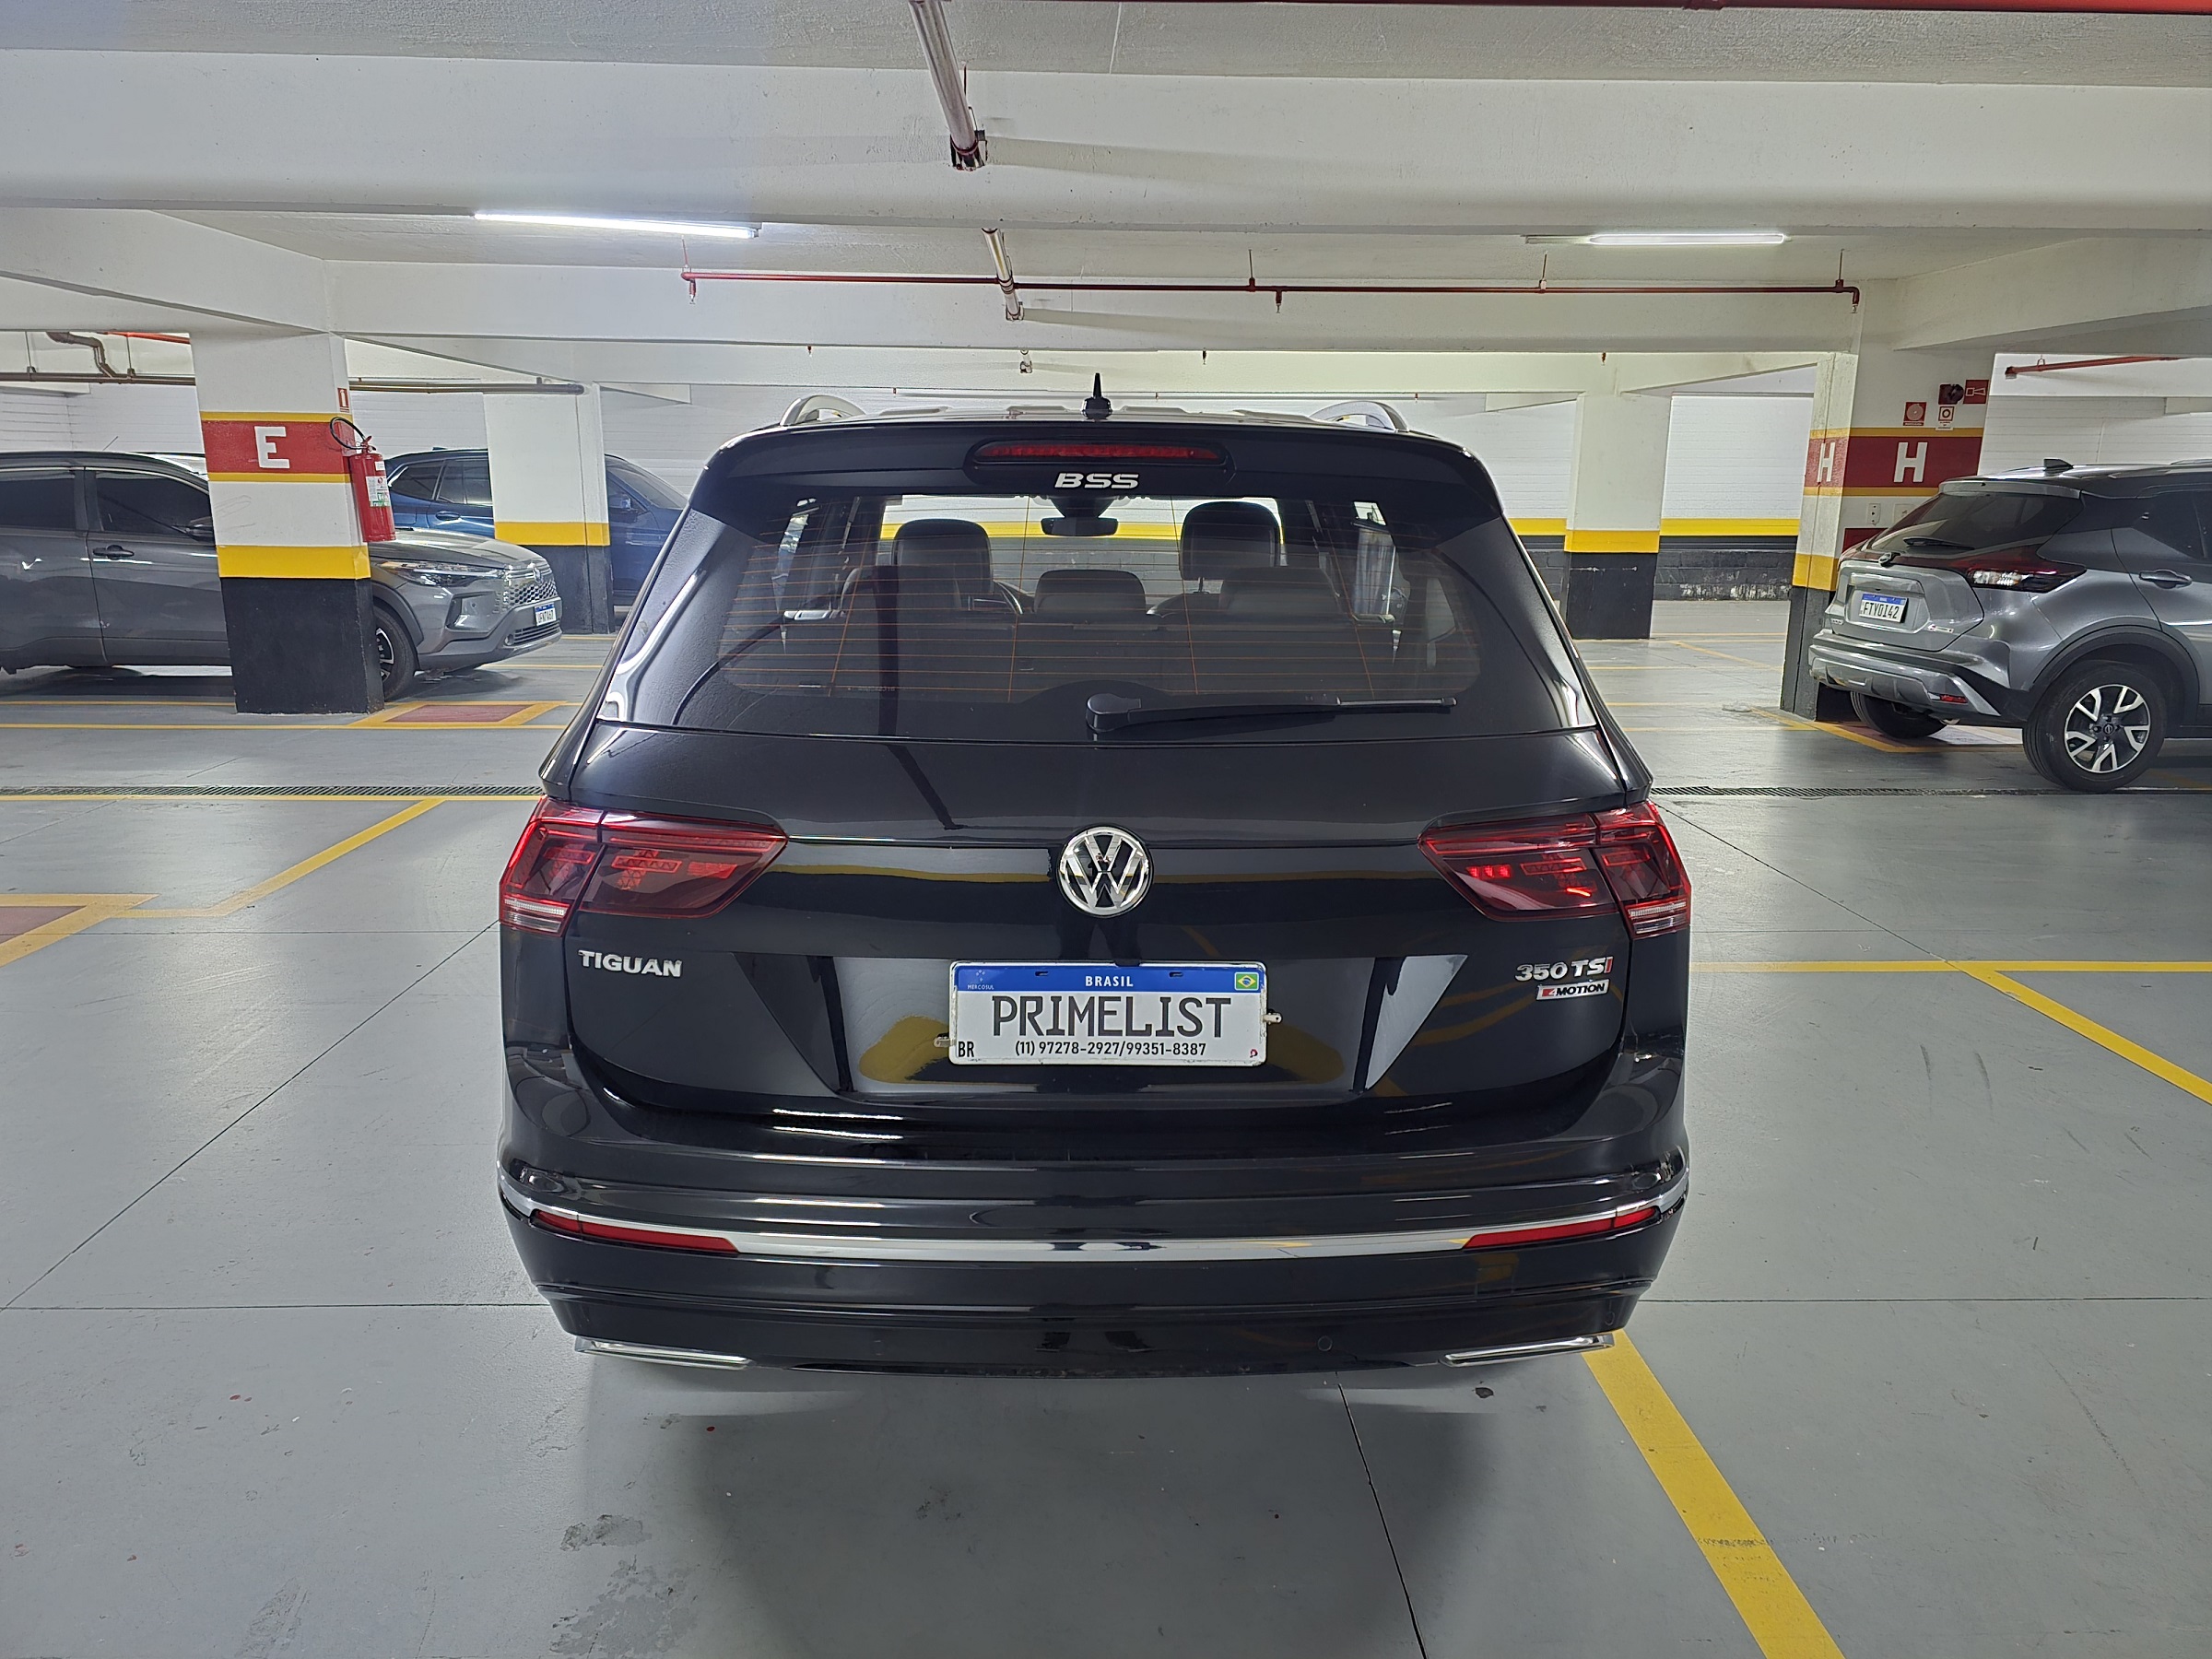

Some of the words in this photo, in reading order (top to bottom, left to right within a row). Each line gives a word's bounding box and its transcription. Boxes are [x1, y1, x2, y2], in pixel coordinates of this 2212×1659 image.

[254, 426, 290, 469] E
[1817, 441, 1836, 482] H
[1893, 441, 1928, 483] H
[1054, 473, 1139, 489] BSS
[578, 949, 683, 978] TIGUAN
[1514, 961, 1569, 982] 350
[1085, 975, 1134, 988] BRASIL
[992, 995, 1231, 1038] PRIMELIST
[958, 1041, 975, 1058] BR
[1015, 1040, 1036, 1056] (11)
[1039, 1041, 1206, 1056] 97278-2927/99351-8387
